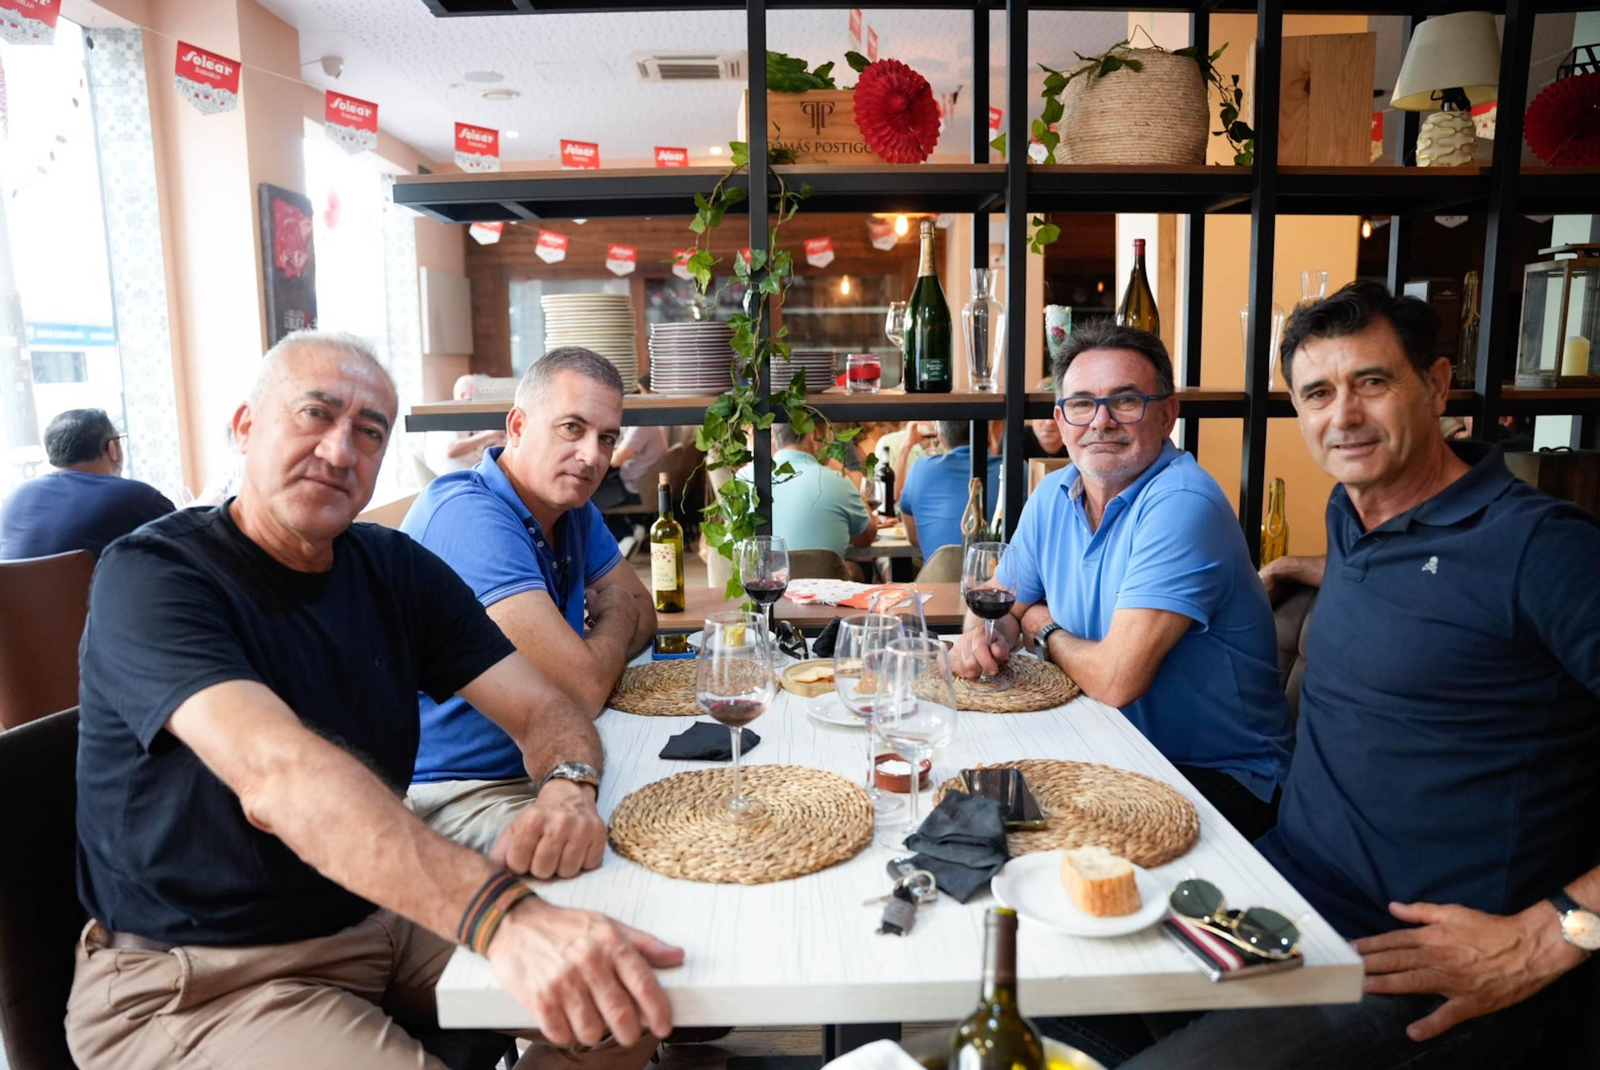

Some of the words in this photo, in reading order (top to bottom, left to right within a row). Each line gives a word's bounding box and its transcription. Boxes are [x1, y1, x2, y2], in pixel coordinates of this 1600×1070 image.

[182, 51, 233, 76] Solear
[330, 97, 372, 118] Solear
[458, 127, 495, 144] Solear
